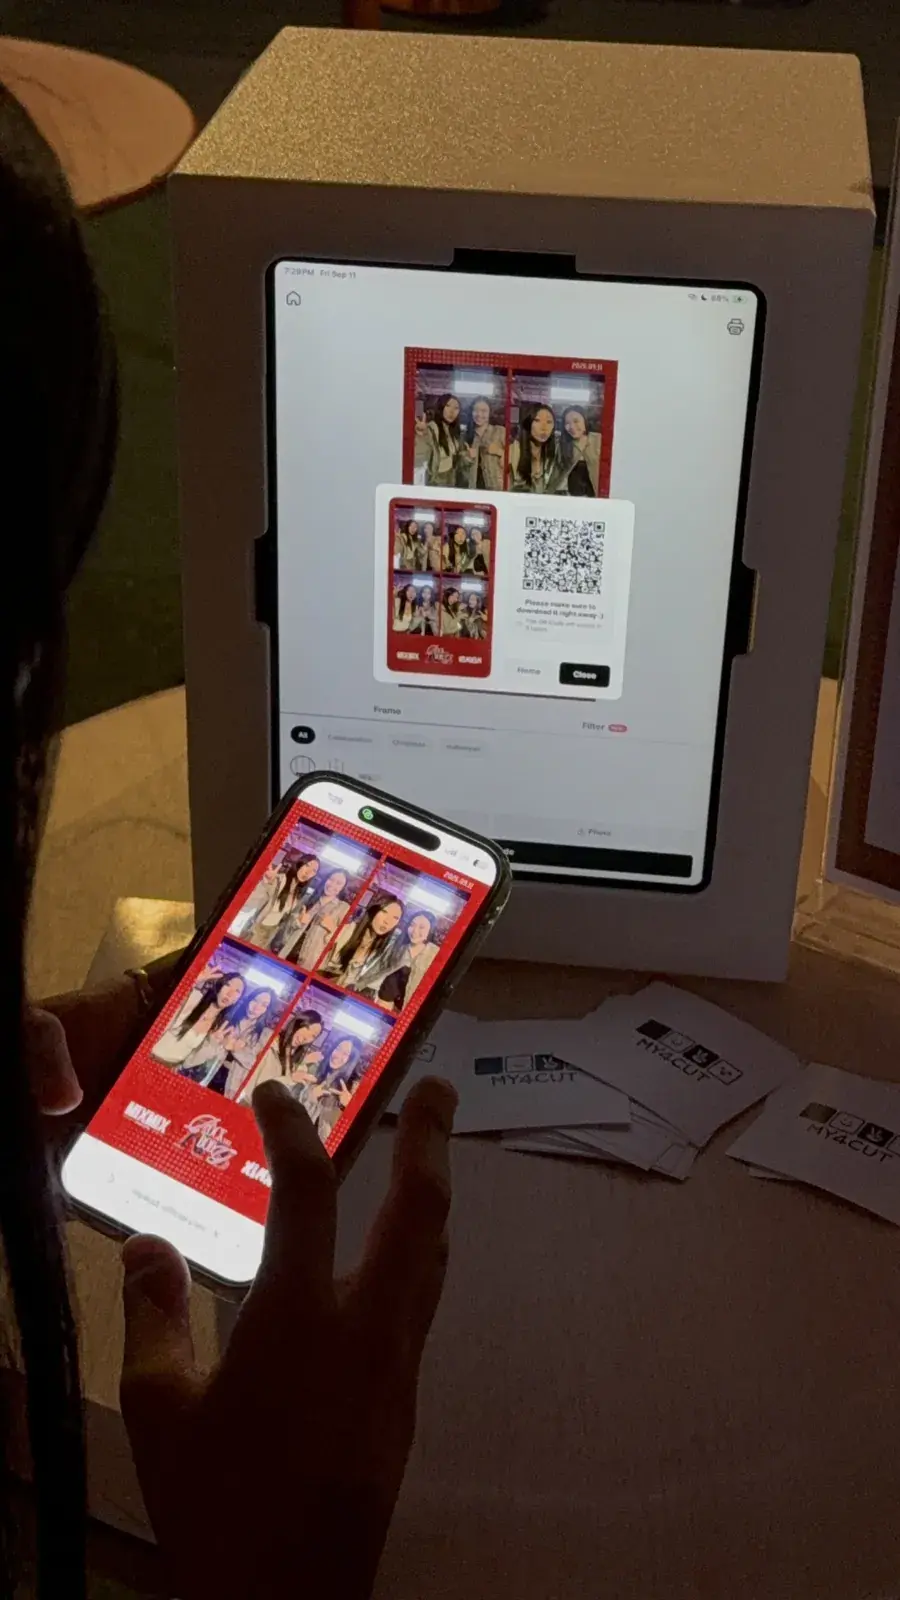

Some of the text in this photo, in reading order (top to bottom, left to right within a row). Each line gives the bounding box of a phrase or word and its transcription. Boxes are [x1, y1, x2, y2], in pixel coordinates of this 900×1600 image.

[320, 269, 330, 277] Fri
[332, 271, 346, 279] Sep
[525, 599, 549, 607] Please
[516, 607, 552, 616] download
[560, 610, 577, 618] right
[517, 667, 542, 675] Home
[573, 670, 597, 680] Close
[373, 705, 402, 715] Frame
[582, 721, 606, 731] Filter
[298, 731, 308, 739] All
[636, 1037, 711, 1084] MY4CUT
[490, 1071, 577, 1087] MY4CUT
[806, 1123, 893, 1163] MY4CUT
